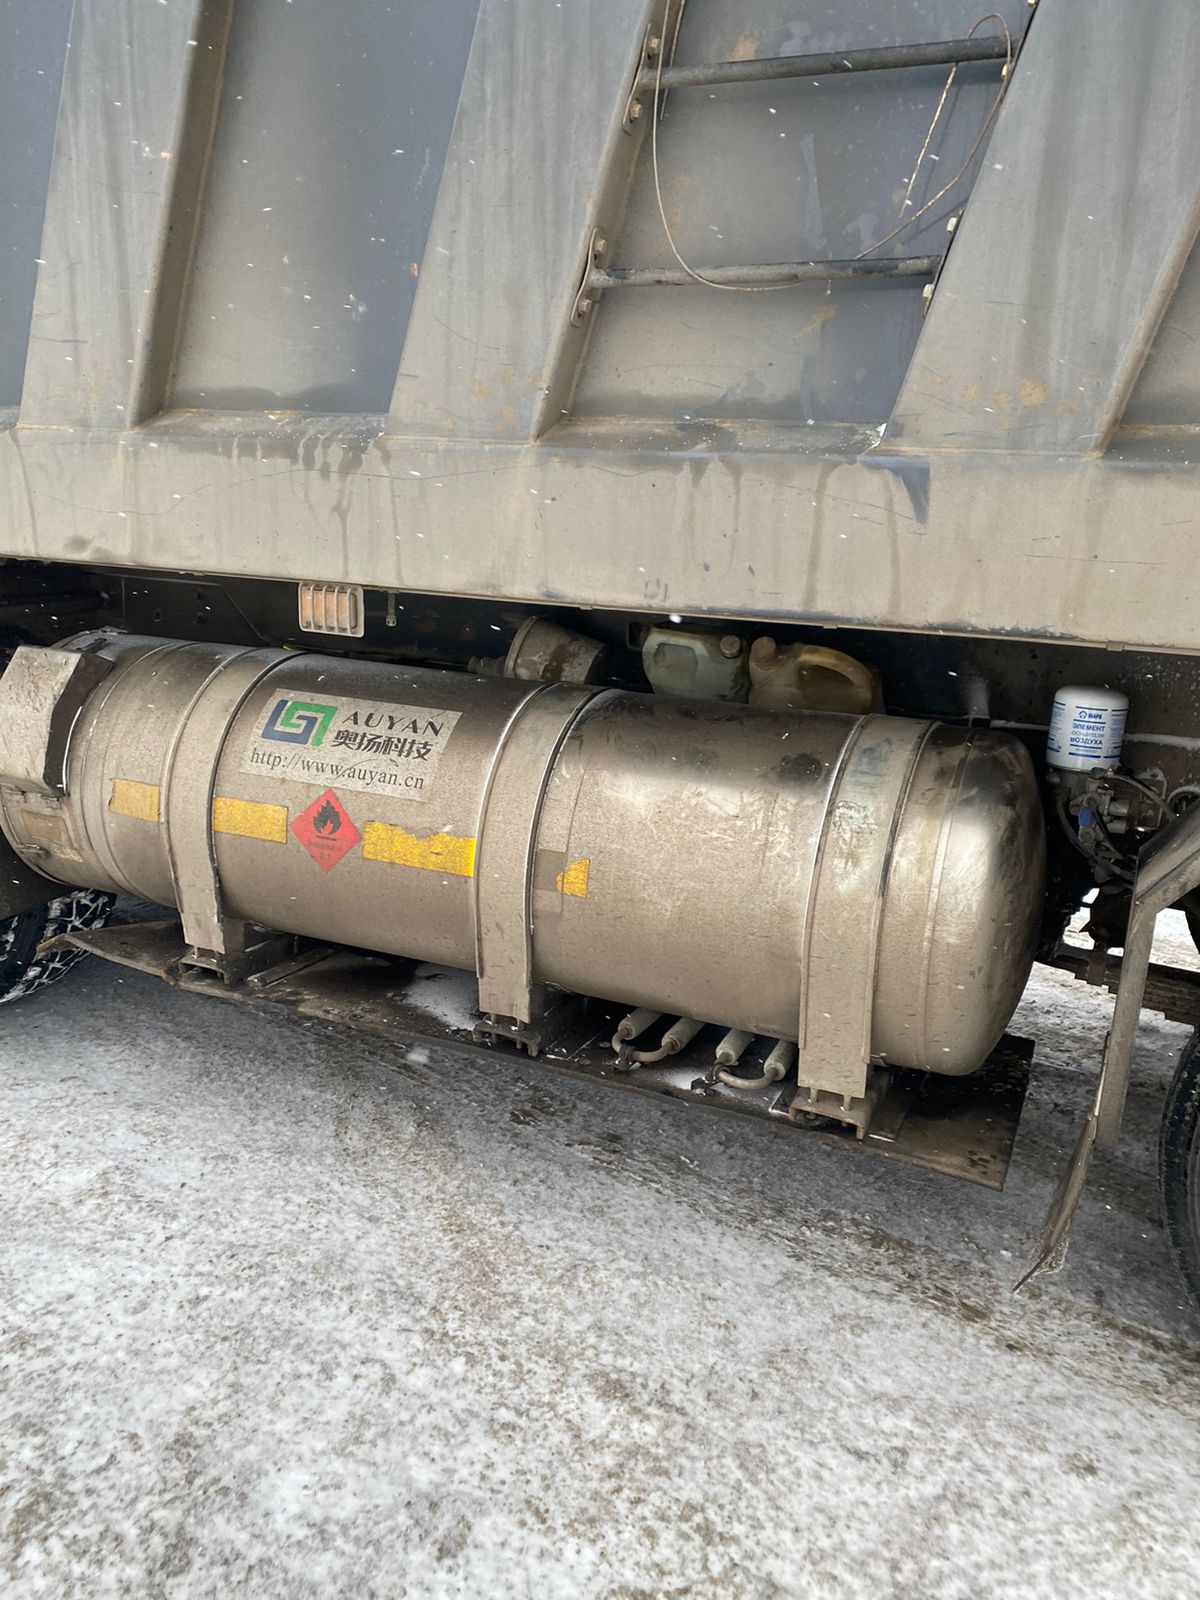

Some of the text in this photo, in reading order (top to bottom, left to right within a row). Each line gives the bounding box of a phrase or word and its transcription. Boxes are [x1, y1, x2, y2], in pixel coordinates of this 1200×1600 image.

[342, 710, 445, 737] AUYAN
[1072, 723, 1106, 732] ЭЛЕМЕНТ
[331, 729, 434, 762] 奥扬科技
[1070, 737, 1103, 745] ВОЗДУХА
[250, 747, 425, 790] http://www.auyan.cn
